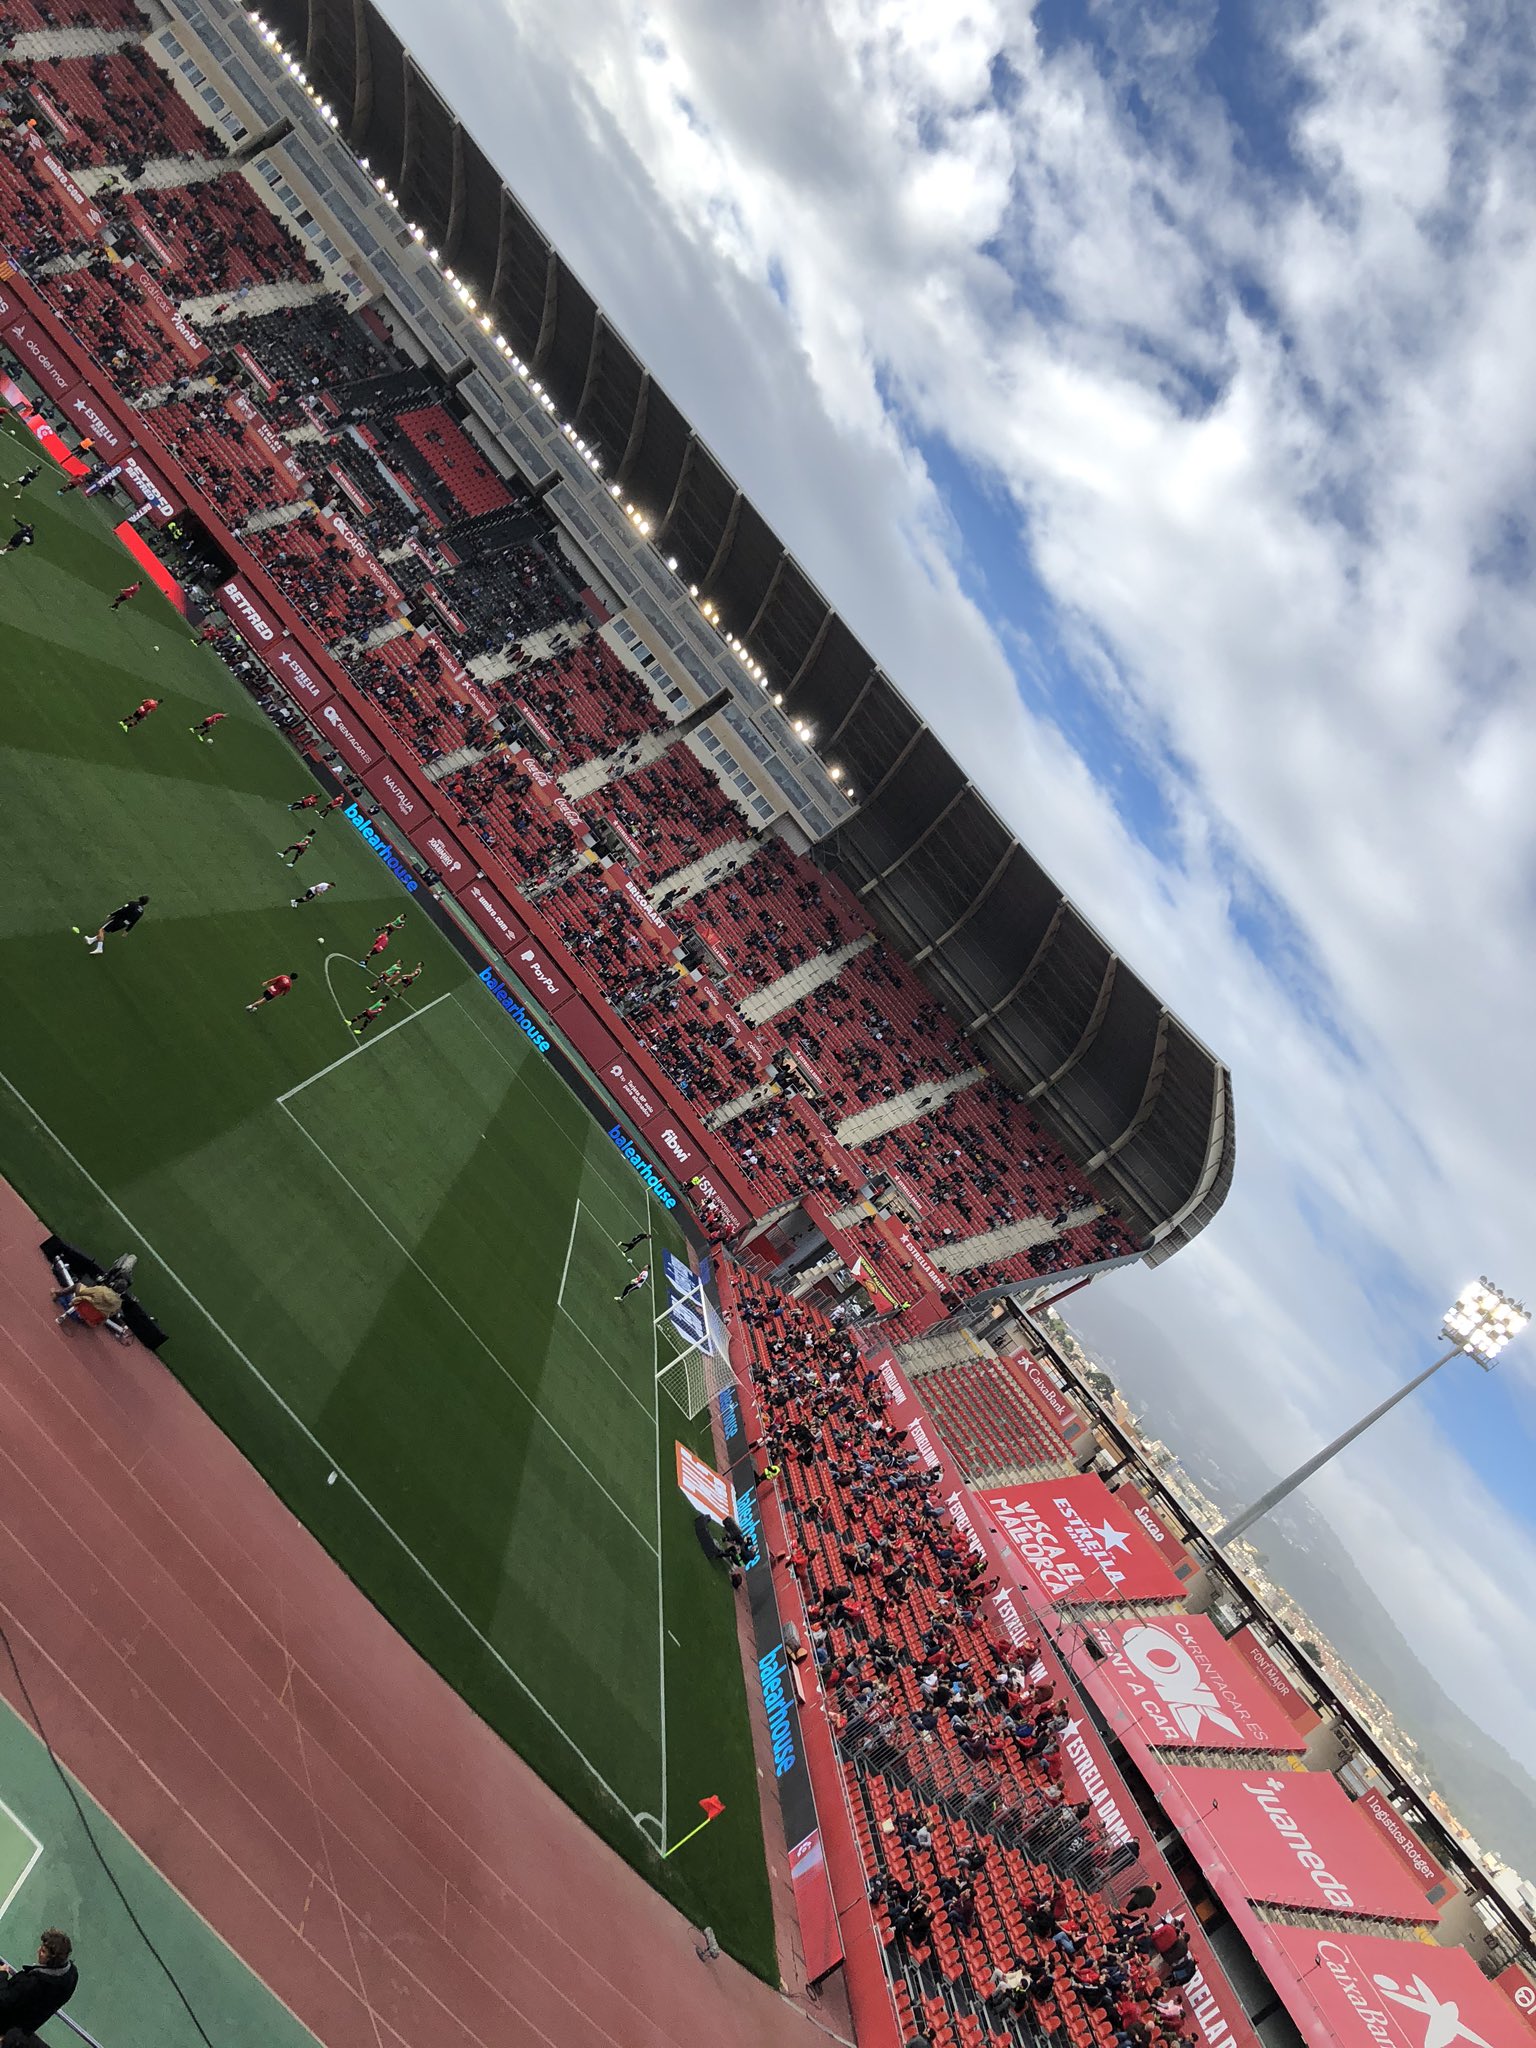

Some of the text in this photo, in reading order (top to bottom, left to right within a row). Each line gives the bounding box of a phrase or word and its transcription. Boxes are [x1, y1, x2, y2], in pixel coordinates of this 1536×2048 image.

[44, 155, 84, 204] umbro.com
[26, 339, 68, 388] ola del mar
[84, 408, 117, 446] ESTRELLA
[125, 466, 154, 500] BETFRED
[224, 583, 273, 640] BETFRED
[289, 660, 319, 696] ESTRELLA
[435, 645, 457, 673] CaixaBank
[468, 687, 491, 716] CaixaBank
[383, 775, 413, 812] NAUTALIA
[344, 803, 417, 891] balearhouse
[478, 896, 508, 931] umbro.com
[625, 881, 665, 928] BRICOMART
[530, 963, 559, 994] PayPal
[703, 986, 719, 1006] Catering
[479, 966, 549, 1052] balearhouse
[725, 1013, 741, 1033] Catering
[746, 1041, 763, 1060] Catering
[622, 1084, 650, 1117] para abonados
[627, 1080, 653, 1113] Tarjeta BP solo
[609, 1125, 676, 1208] balearhouse
[661, 1129, 690, 1162] fibwi
[715, 1195, 740, 1227] INMOBILIARIA
[906, 1242, 946, 1291] ESTRELLA DAMM
[882, 1366, 899, 1390] ESTRELLA
[1029, 1368, 1065, 1415] CaixaBank
[911, 1425, 932, 1456] ESTRELLA
[949, 1501, 974, 1536] ESTRELLA
[1052, 1497, 1126, 1585] ESTRELLA
[1063, 1526, 1092, 1557] DAMM
[989, 1498, 1069, 1595] MALLORCA
[1014, 1500, 1085, 1587] VISCA EL
[998, 1601, 1029, 1648] ESTRELL
[1093, 1626, 1180, 1740] RENT A CAR
[1122, 1622, 1244, 1743] OK
[1175, 1622, 1269, 1742] OKRENTACAR.ES
[1250, 1648, 1270, 1670] FONT
[1265, 1668, 1289, 1696] MAJOR
[759, 1645, 794, 1776] balearhouse
[1066, 1736, 1109, 1806] ESTRELLA
[1242, 1777, 1354, 1907] juaneda
[1370, 1799, 1434, 1878] logistics Rotger
